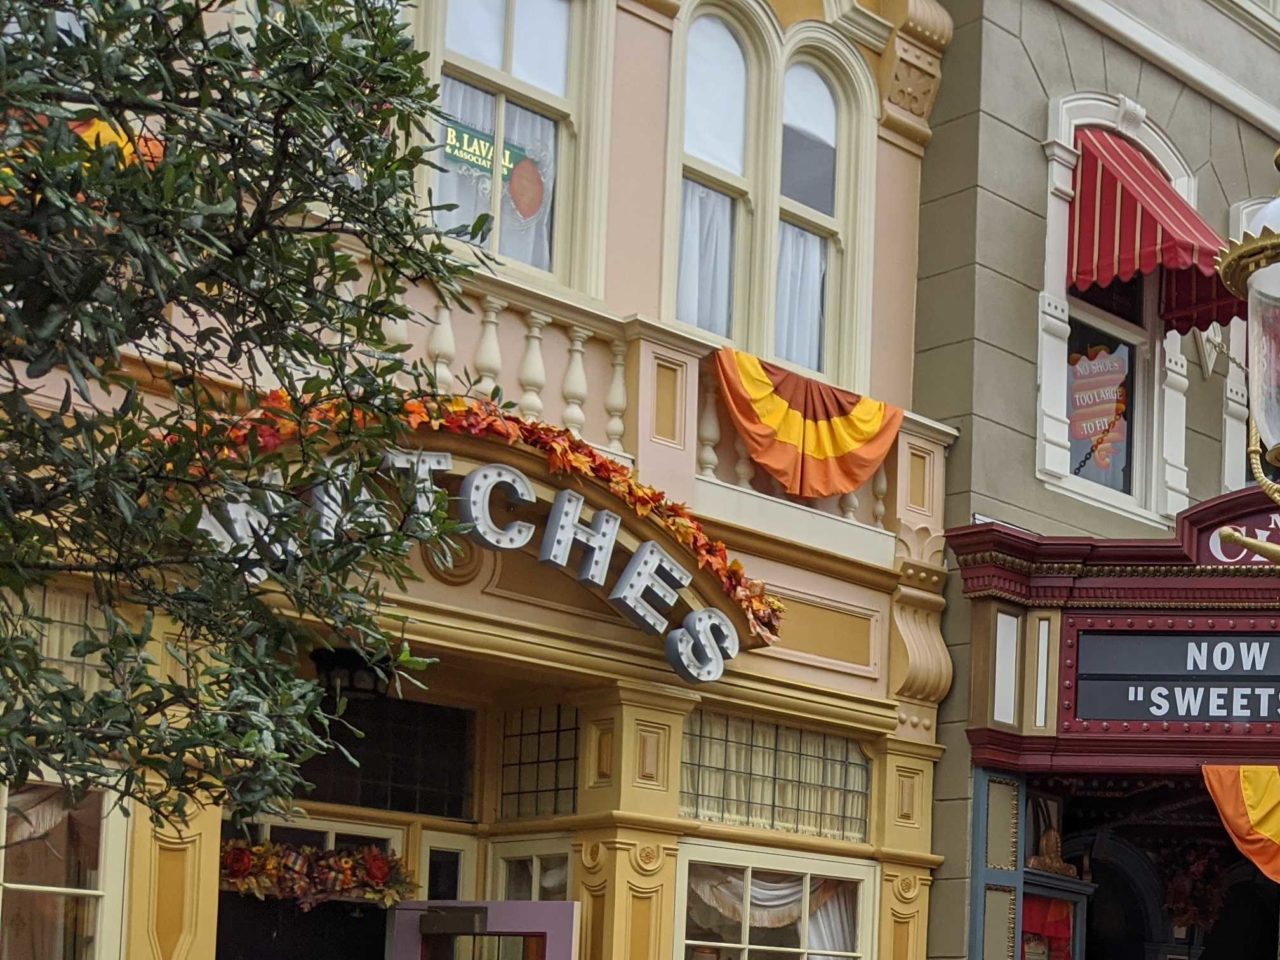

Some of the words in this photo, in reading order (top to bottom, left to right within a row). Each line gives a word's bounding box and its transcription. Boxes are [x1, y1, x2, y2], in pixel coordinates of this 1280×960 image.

[446, 127, 460, 147] B.
[453, 148, 508, 175] ASSOCIATS
[1091, 359, 1120, 374] SHOES
[1074, 391, 1094, 407] TOO
[1094, 385, 1122, 402] LARGE
[1095, 417, 1110, 432] FIT
[1186, 641, 1270, 672] NOW
